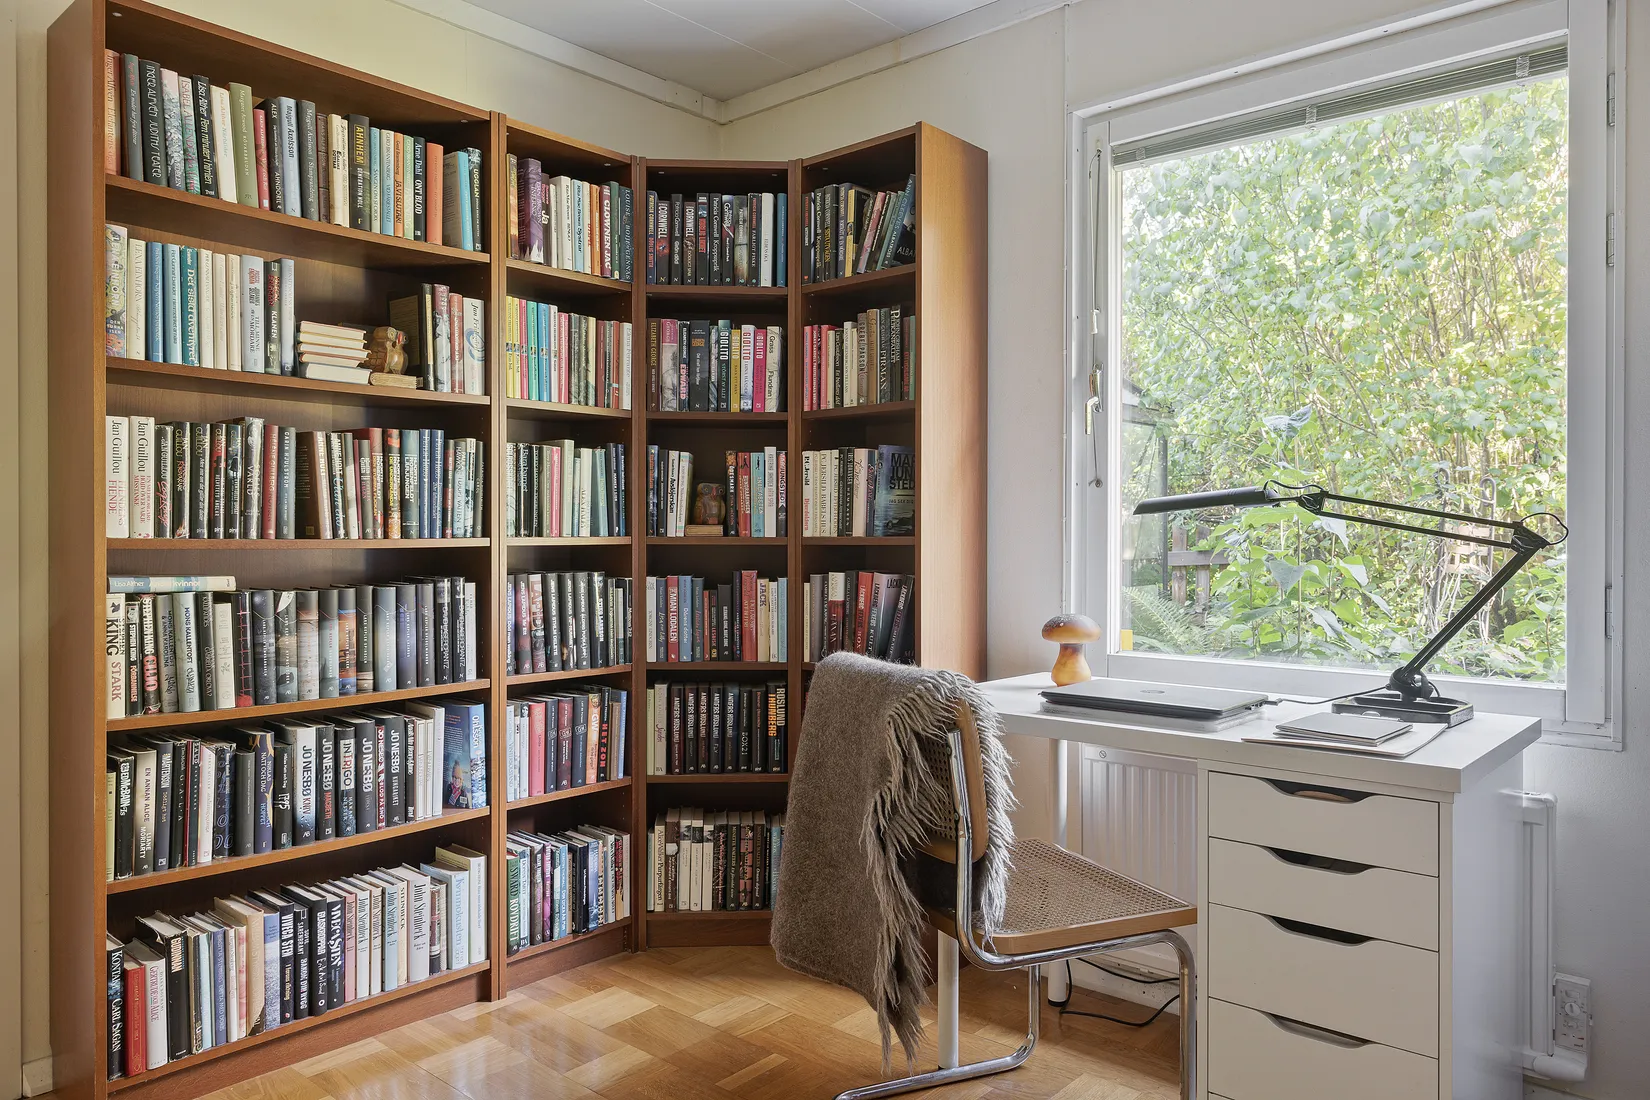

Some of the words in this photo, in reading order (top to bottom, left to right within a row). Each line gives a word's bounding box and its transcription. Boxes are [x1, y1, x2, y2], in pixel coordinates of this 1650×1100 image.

[355, 126, 365, 164] AHNHEM
[541, 210, 550, 225] Ja
[603, 199, 611, 249] CLOWNEN
[604, 250, 612, 270] JAC
[719, 331, 729, 361] GIOLITO
[742, 331, 752, 361] GIOLITO
[755, 336, 764, 360] GIOLITO
[111, 420, 122, 436] Jan
[137, 420, 148, 437] Jan
[111, 436, 123, 474] Guillou
[137, 437, 149, 473] Guillou
[759, 582, 767, 607] JACK
[106, 618, 119, 656] KING
[111, 661, 122, 702] STARK
[143, 655, 158, 692] CUJO
[768, 693, 777, 737] THUNBERG
[776, 688, 786, 727] ROSLUND
[390, 729, 400, 742] JO
[591, 713, 599, 732] GW
[601, 723, 609, 744] HET
[302, 745, 313, 760] JO
[322, 738, 333, 753] JO
[362, 737, 374, 753] JO
[599, 746, 608, 768] ZON
[341, 743, 353, 787] INTRIGO
[362, 753, 374, 793] NESBØ
[413, 883, 427, 903] John
[413, 903, 427, 941] Steinbeck
[111, 998, 123, 1020] CARL
[111, 1023, 124, 1053] SAGAN
